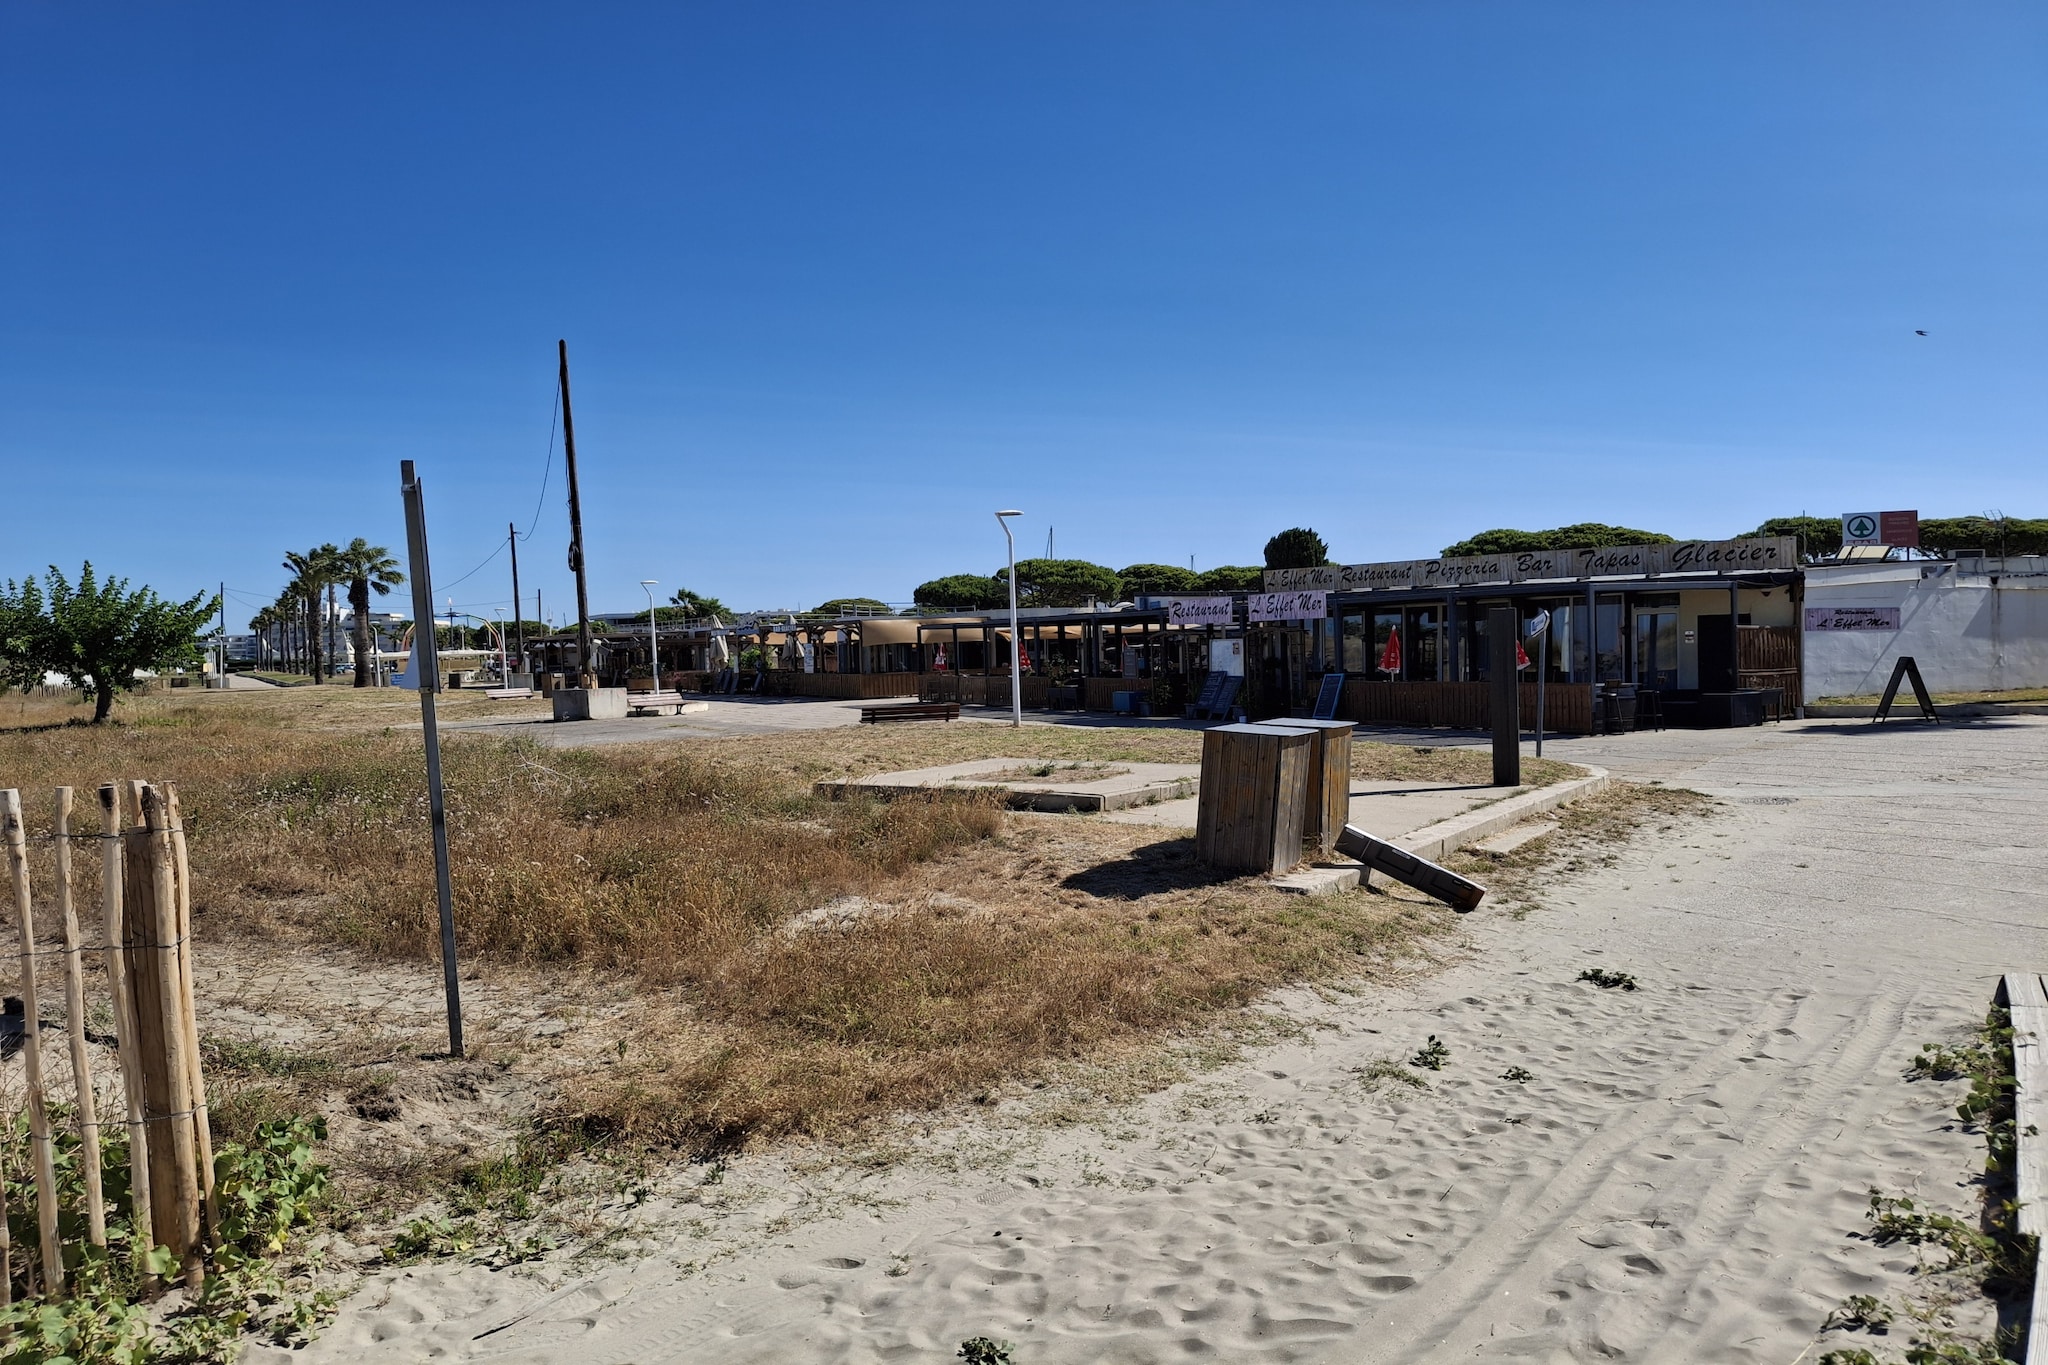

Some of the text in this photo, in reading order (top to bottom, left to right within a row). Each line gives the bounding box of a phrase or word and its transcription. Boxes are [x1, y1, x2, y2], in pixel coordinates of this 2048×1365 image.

[1311, 568, 1333, 584] Mer
[1340, 565, 1412, 583] Restaurant
[1425, 560, 1500, 582] Pizzeria
[1517, 553, 1553, 572] Bar
[1578, 549, 1641, 570] Tapas
[1672, 543, 1778, 571] Glacier
[1172, 602, 1230, 619] Restaurant
[1297, 593, 1323, 612] Mer
[1866, 618, 1890, 628] Mer
